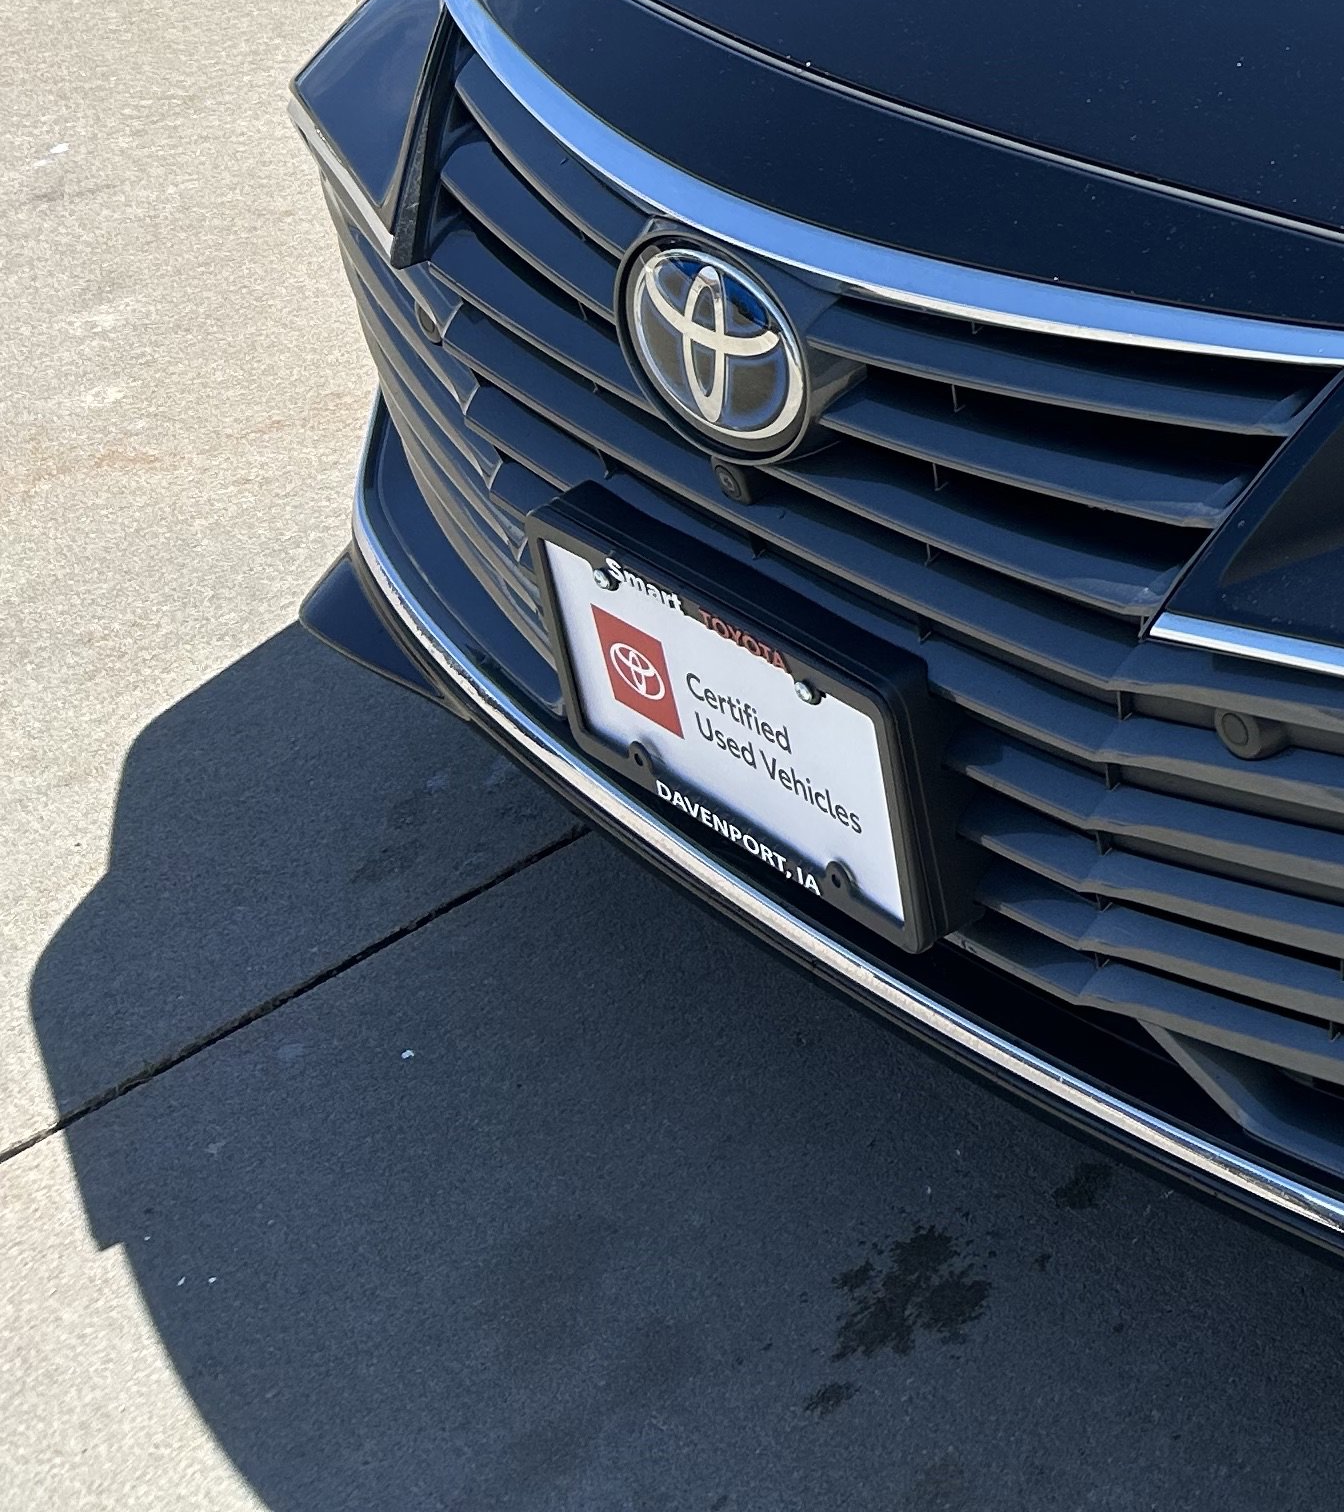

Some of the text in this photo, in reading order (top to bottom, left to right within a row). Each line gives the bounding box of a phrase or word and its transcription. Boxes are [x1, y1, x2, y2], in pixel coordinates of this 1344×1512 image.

[605, 557, 789, 673] Smart TOYOTA
[685, 671, 791, 755] Certified
[694, 711, 863, 835] Used Vehicles
[656, 778, 821, 896] DAVENPORT, IA
